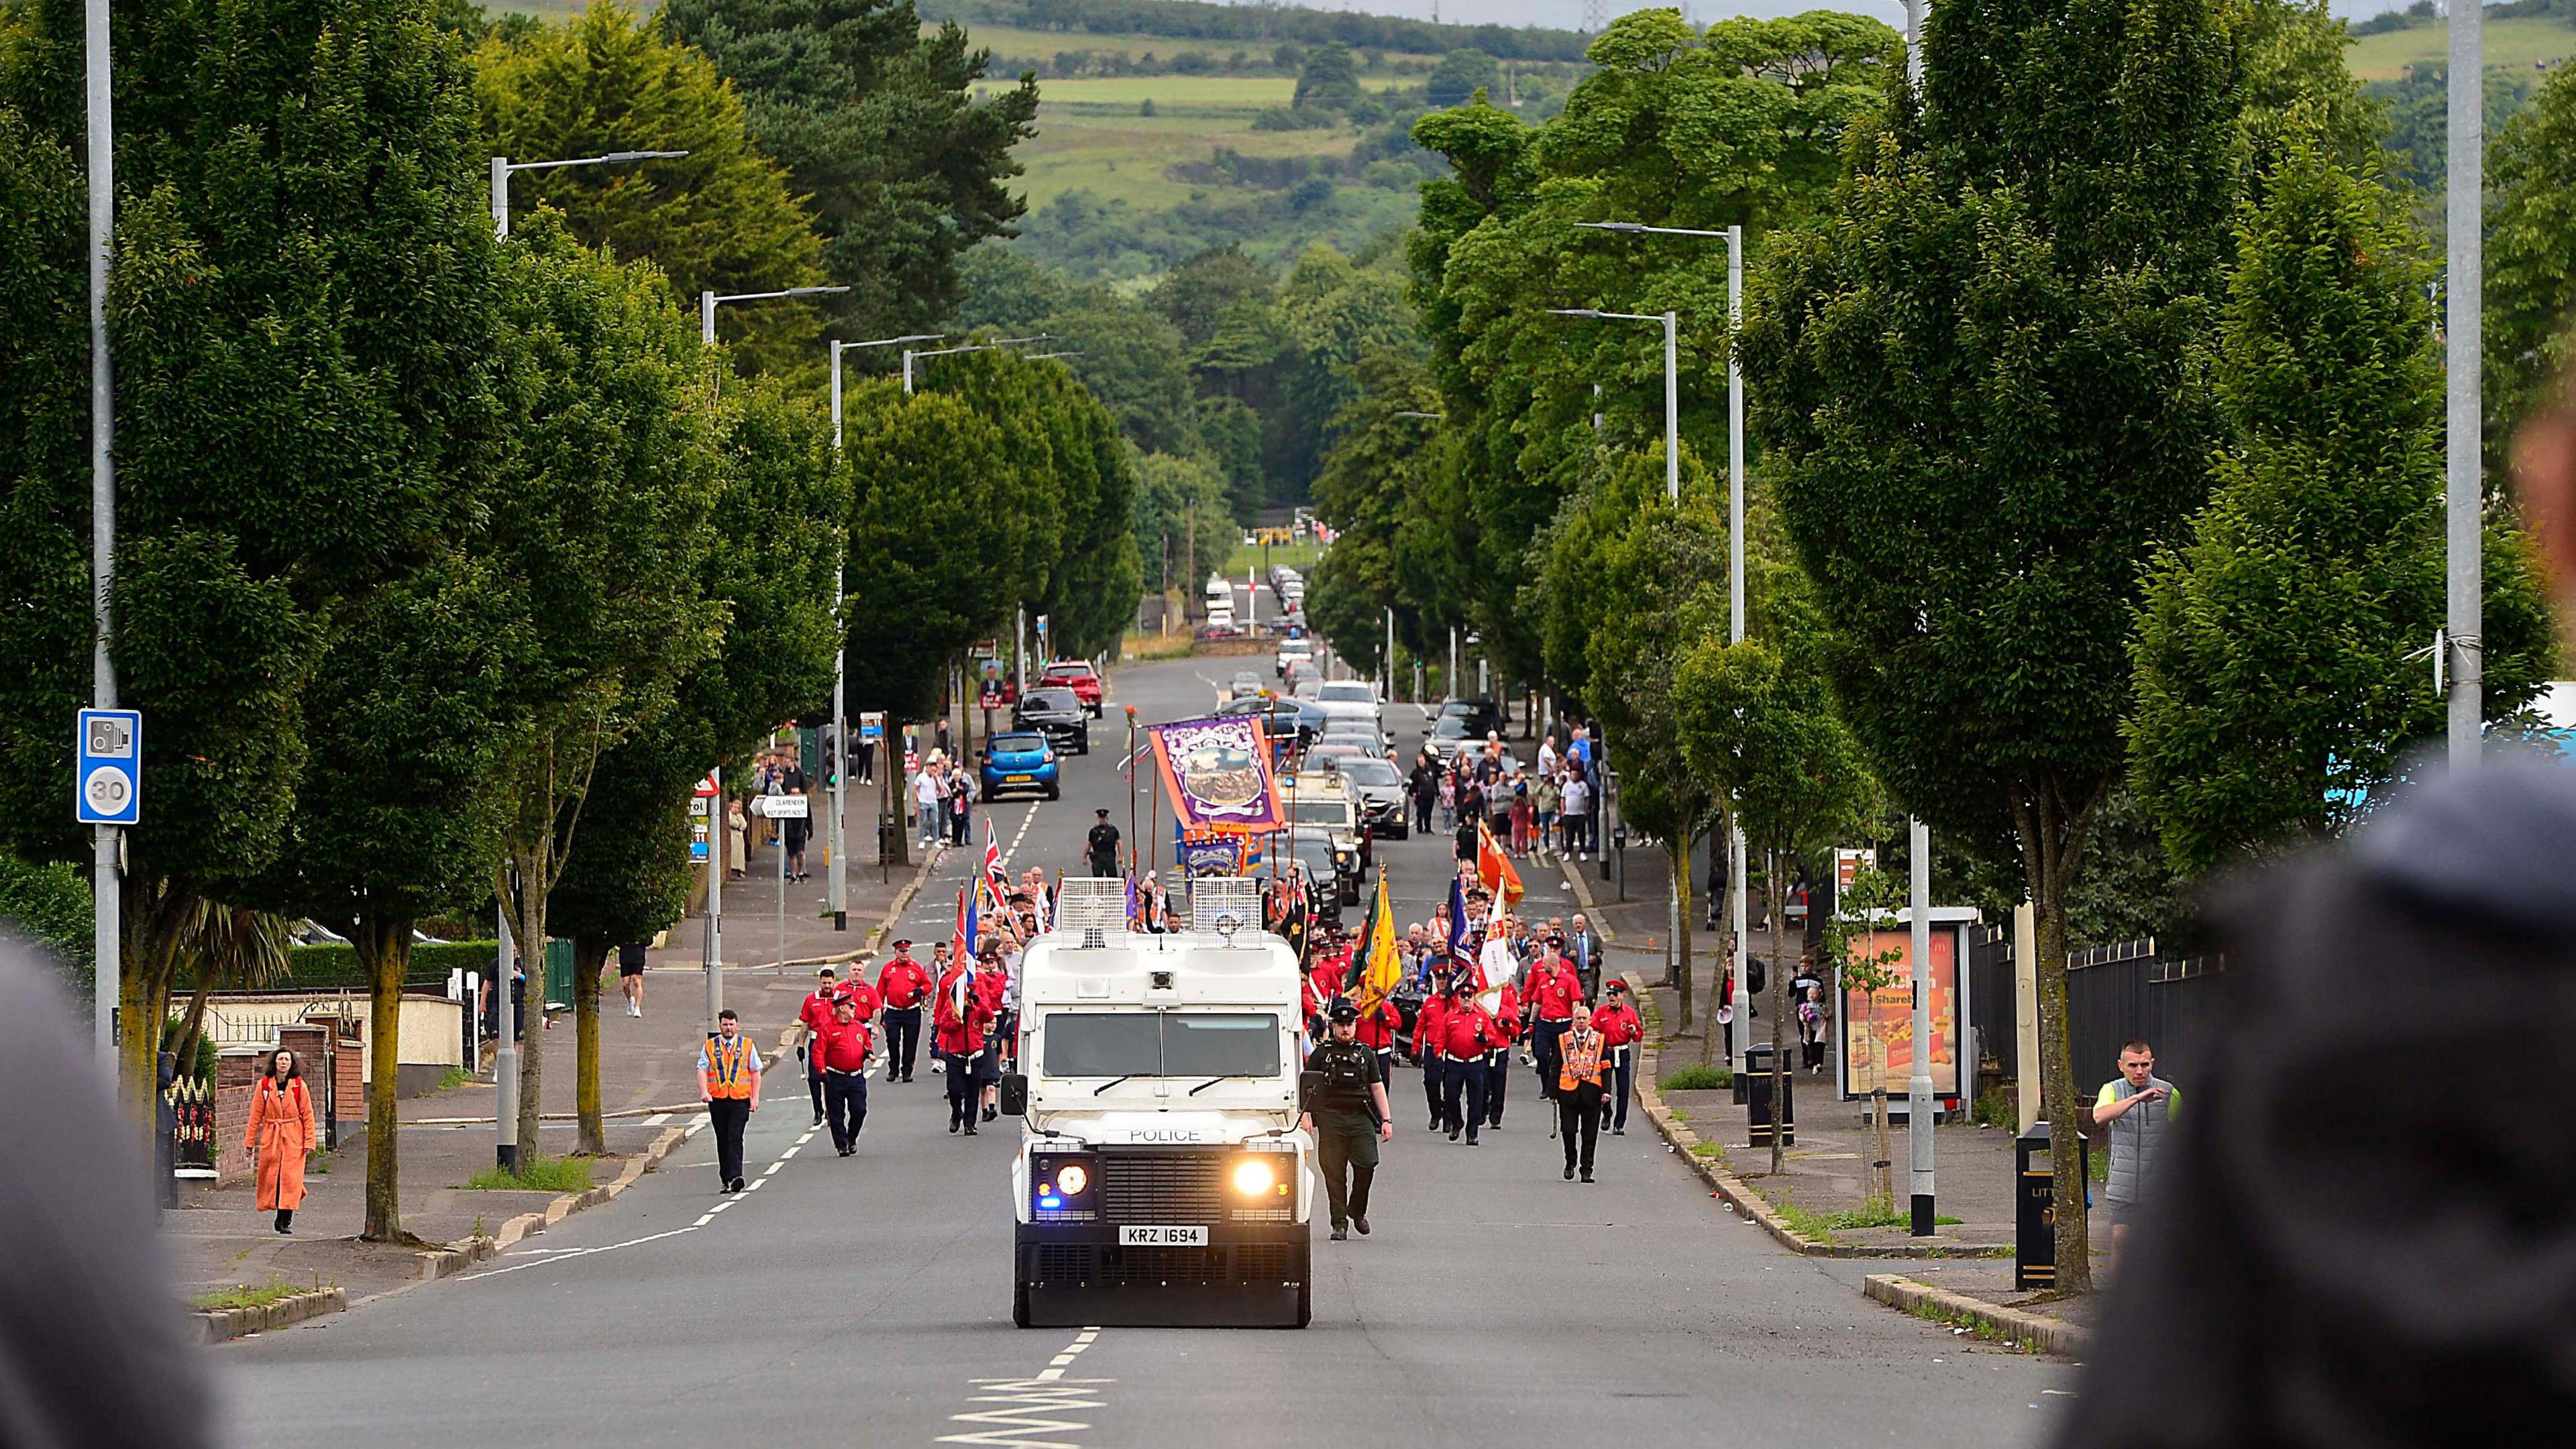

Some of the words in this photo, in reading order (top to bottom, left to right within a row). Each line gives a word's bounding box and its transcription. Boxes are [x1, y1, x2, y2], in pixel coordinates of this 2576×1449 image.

[93, 781, 124, 800] 30
[689, 802, 703, 810] rol
[695, 833, 705, 843] 11
[1876, 995, 1913, 1004] Shareb
[1130, 1130, 1201, 1142] POLICE
[2033, 1188, 2053, 1197] LITT
[1128, 1229, 1158, 1242] KRZ
[1165, 1229, 1198, 1242] 1694
